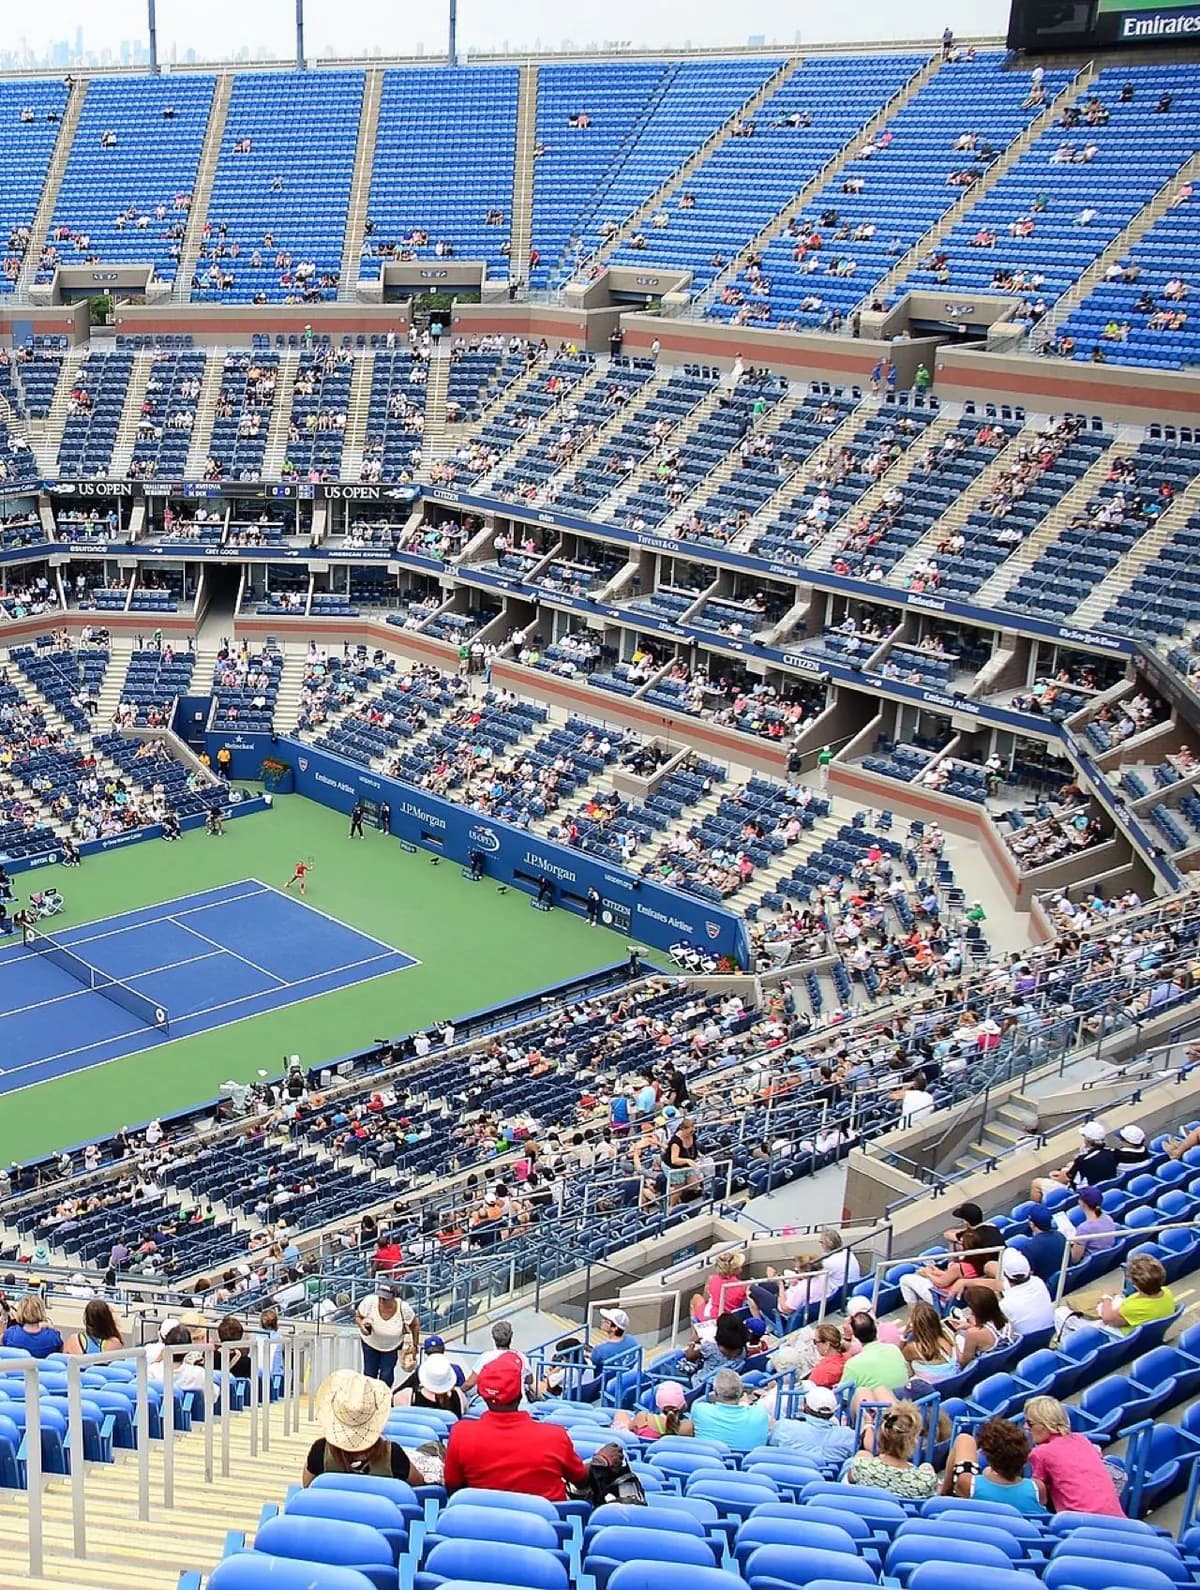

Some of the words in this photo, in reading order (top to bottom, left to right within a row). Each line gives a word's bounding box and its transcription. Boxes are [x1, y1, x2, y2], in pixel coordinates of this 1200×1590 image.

[1123, 14, 1200, 36] Emirates
[78, 484, 95, 496] US
[96, 484, 132, 496] OPEN
[324, 487, 341, 499] US
[342, 487, 380, 499] OPEN
[433, 490, 460, 502] CITIZEN
[444, 564, 460, 577] IBM
[782, 654, 822, 672] CITIZEN
[923, 691, 954, 708] Emirates
[954, 700, 980, 714] Airline
[400, 802, 446, 830] J.P.Morgan
[523, 852, 576, 882] J.P.Morgan
[602, 898, 632, 916] CITIZEN
[636, 903, 668, 924] Emirates
[668, 916, 694, 934] Airline
